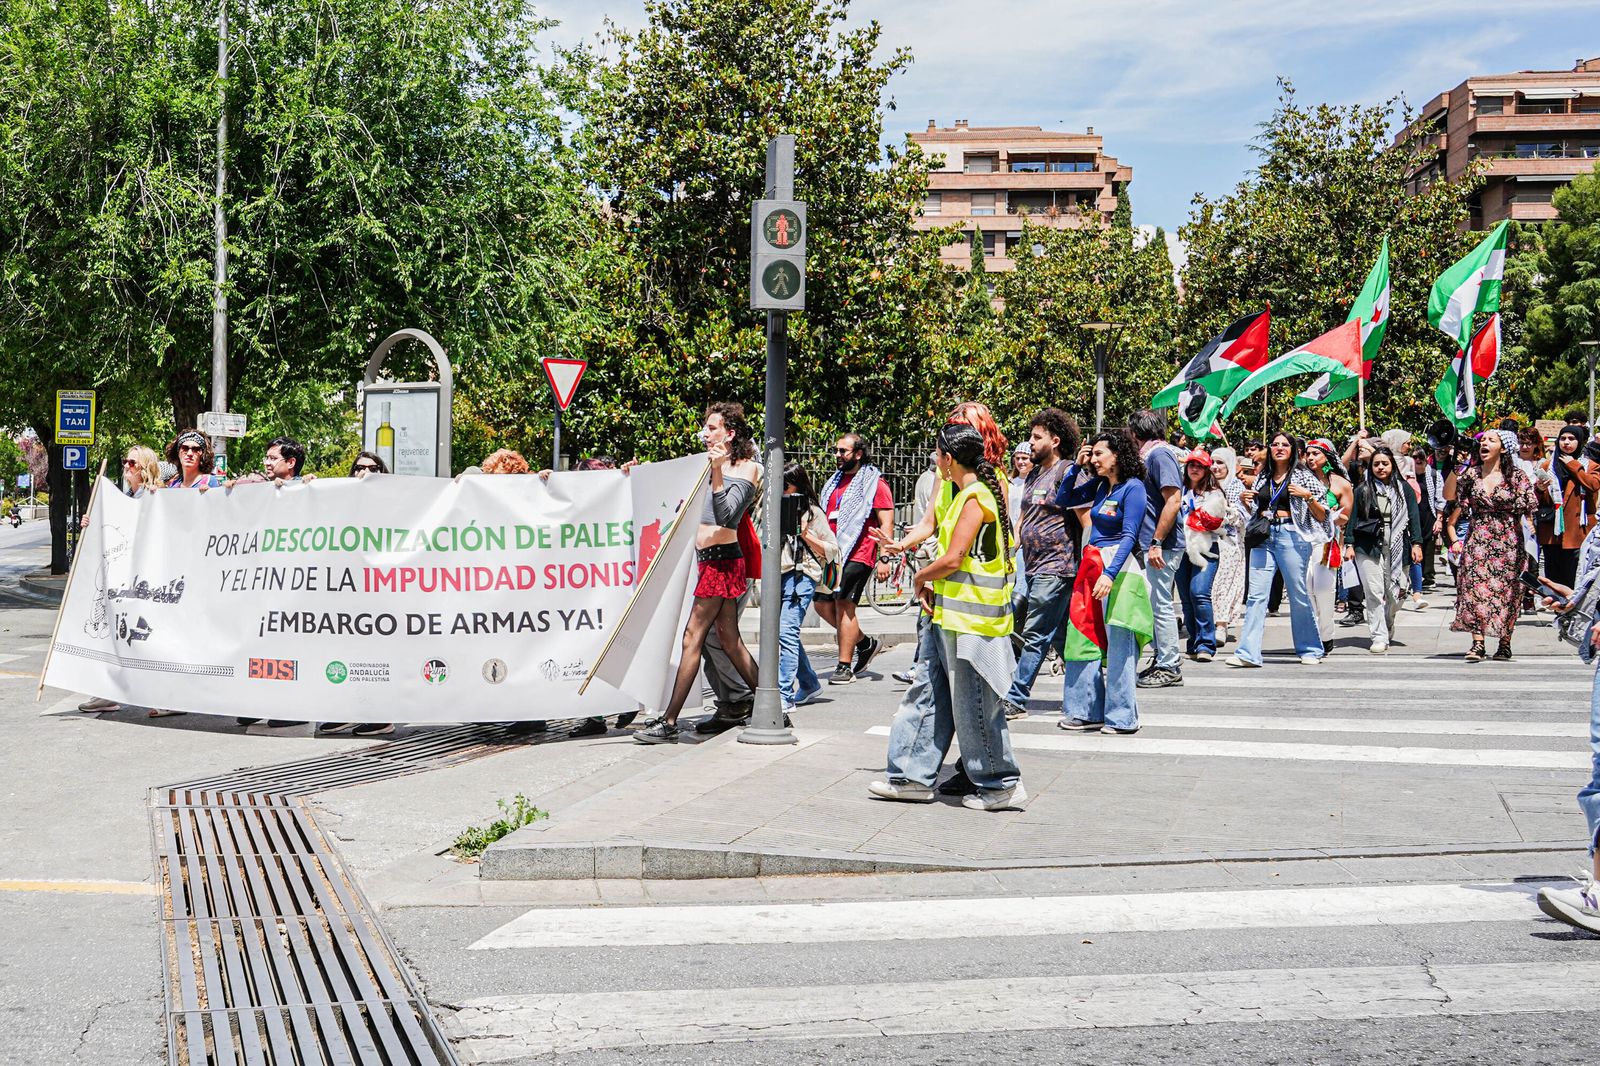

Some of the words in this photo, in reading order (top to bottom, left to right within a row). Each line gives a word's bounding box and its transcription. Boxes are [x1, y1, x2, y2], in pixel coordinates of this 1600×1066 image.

[65, 417, 86, 426] TAXI
[66, 448, 80, 467] P
[205, 533, 240, 557] POR
[242, 531, 259, 555] LA
[261, 519, 506, 553] DESCOLONIZACIÓN
[514, 524, 552, 549] DE
[220, 569, 232, 592] Y
[231, 568, 248, 591] EL
[251, 566, 286, 591] FIN
[290, 566, 318, 591] DE
[326, 566, 357, 592] LA
[363, 564, 536, 593] IMPUNIDAD
[543, 561, 636, 590] SIONIS
[259, 611, 398, 638] ¡EMBARGO
[406, 613, 442, 636] DE
[450, 610, 551, 635] ARMAS
[557, 608, 604, 631] YA!
[249, 658, 295, 680] BDS
[349, 668, 390, 676] ANDALUCÍA
